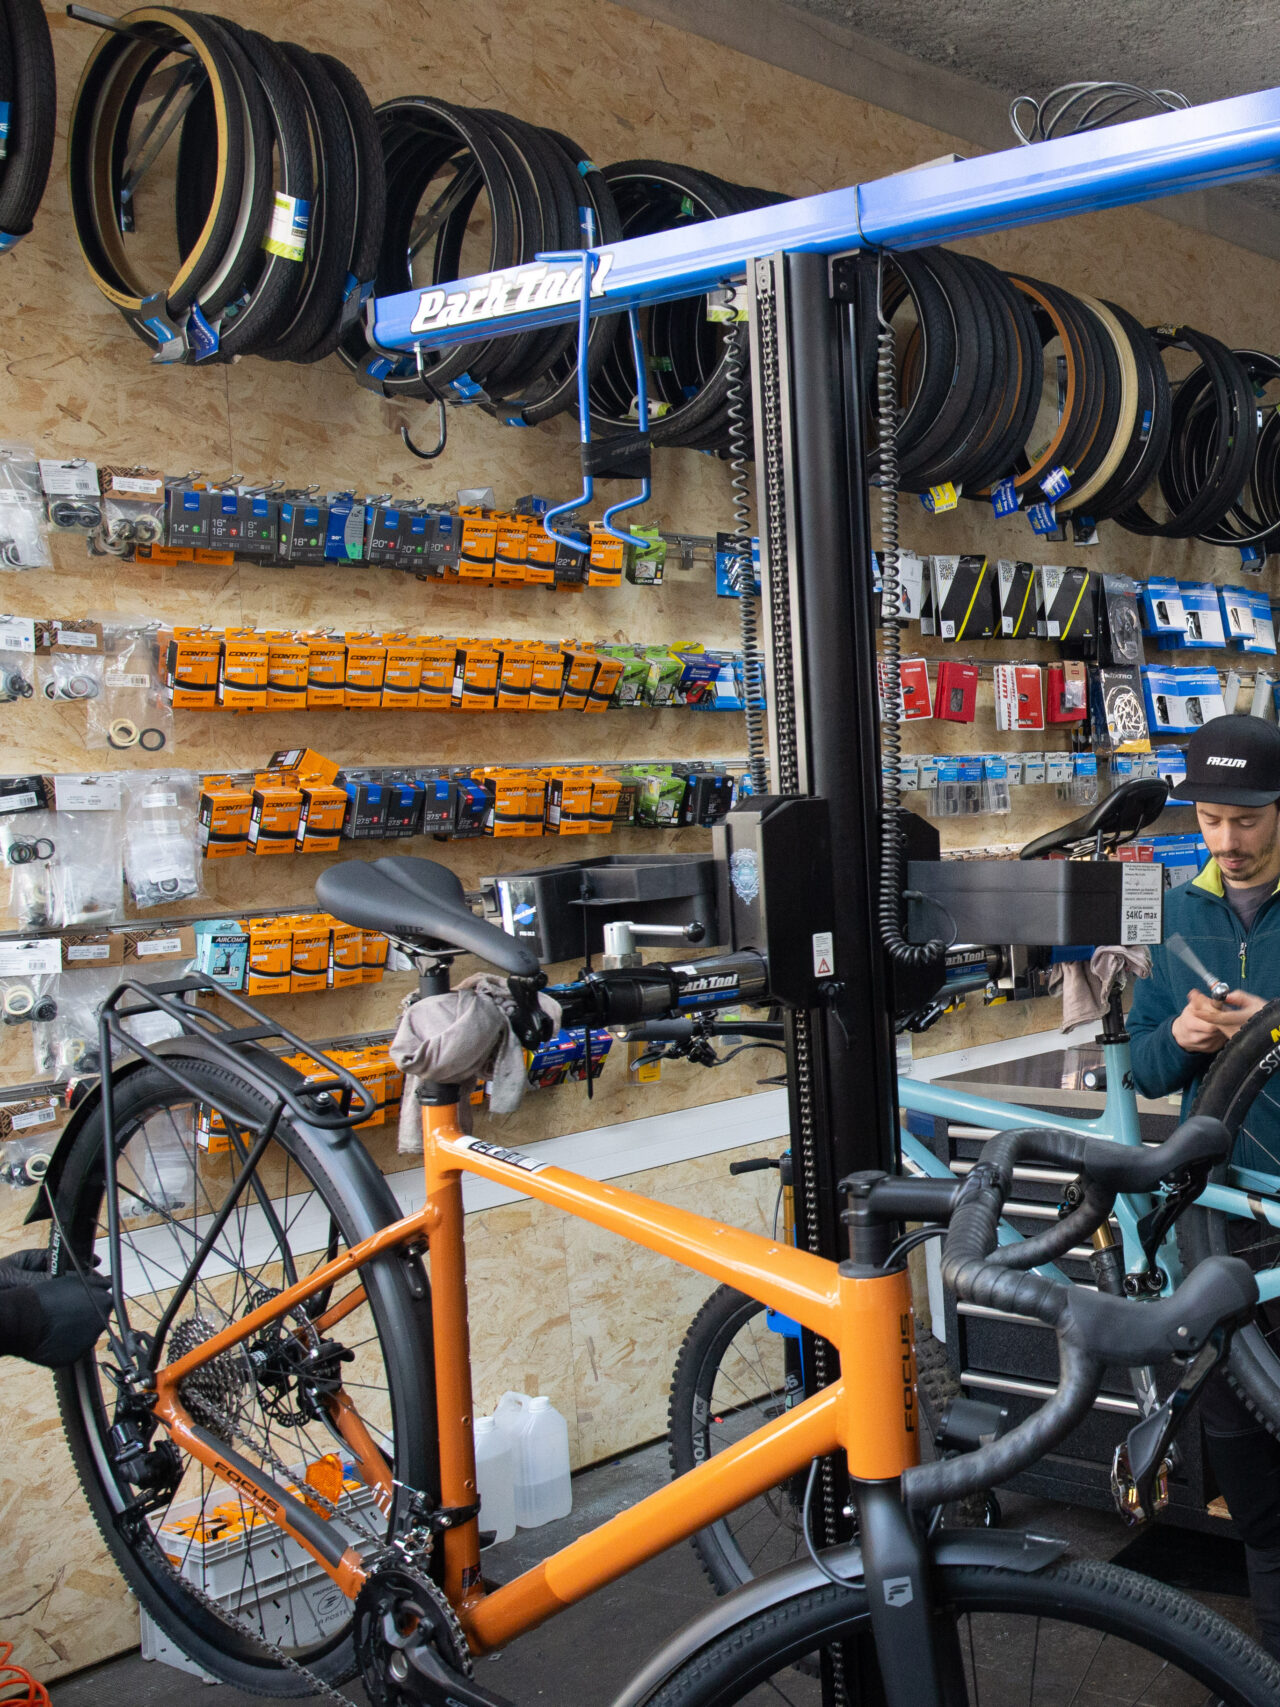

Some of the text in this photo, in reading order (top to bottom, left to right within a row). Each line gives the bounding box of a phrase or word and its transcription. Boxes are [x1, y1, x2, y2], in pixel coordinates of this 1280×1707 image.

[410, 252, 614, 334] Park Tool
[173, 523, 189, 532] 14"
[212, 518, 227, 528] 16"
[212, 527, 227, 536] 18"
[293, 538, 308, 546] 18"
[372, 539, 388, 548] 20"
[557, 558, 571, 566] 22"
[1206, 756, 1248, 769] FAZUA
[215, 804, 242, 812] CONTI
[1126, 910, 1158, 920] 54KG max
[215, 936, 246, 944] AIRCOMP
[305, 941, 328, 949] TUBE
[946, 950, 985, 966] ark Tool
[708, 973, 739, 989] Tool
[359, 1074, 377, 1082] ONTI
[900, 1313, 915, 1432] FOCUS
[214, 1461, 280, 1512] FOCUS
[325, 1610, 347, 1623] POSTE
